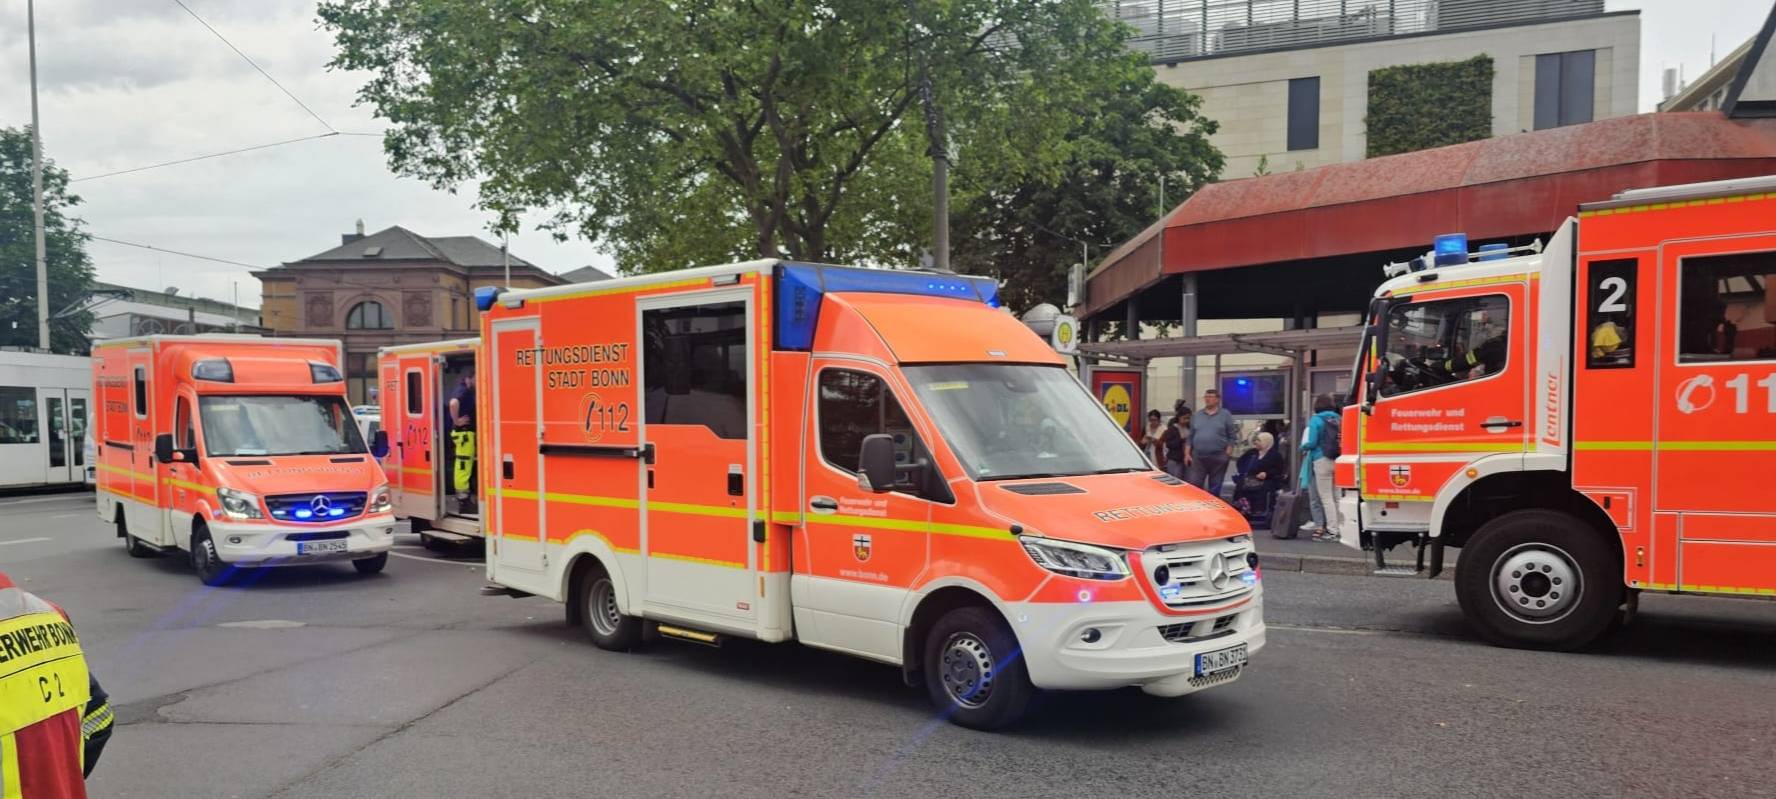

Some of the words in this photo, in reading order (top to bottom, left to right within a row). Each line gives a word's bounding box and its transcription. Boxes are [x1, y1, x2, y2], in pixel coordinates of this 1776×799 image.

[1598, 276, 1627, 313] 2
[516, 344, 628, 366] RETTUNGSDIENST
[548, 370, 586, 388] STADT
[591, 369, 630, 387] BONN
[598, 403, 629, 431] 112
[1391, 408, 1442, 417] Feuerwehr
[1446, 408, 1465, 417] und
[412, 426, 428, 446] 112
[1391, 423, 1465, 433] Rettungsdienst
[1202, 655, 1214, 671] BN
[39, 676, 52, 703] C
[54, 672, 65, 698] 2
